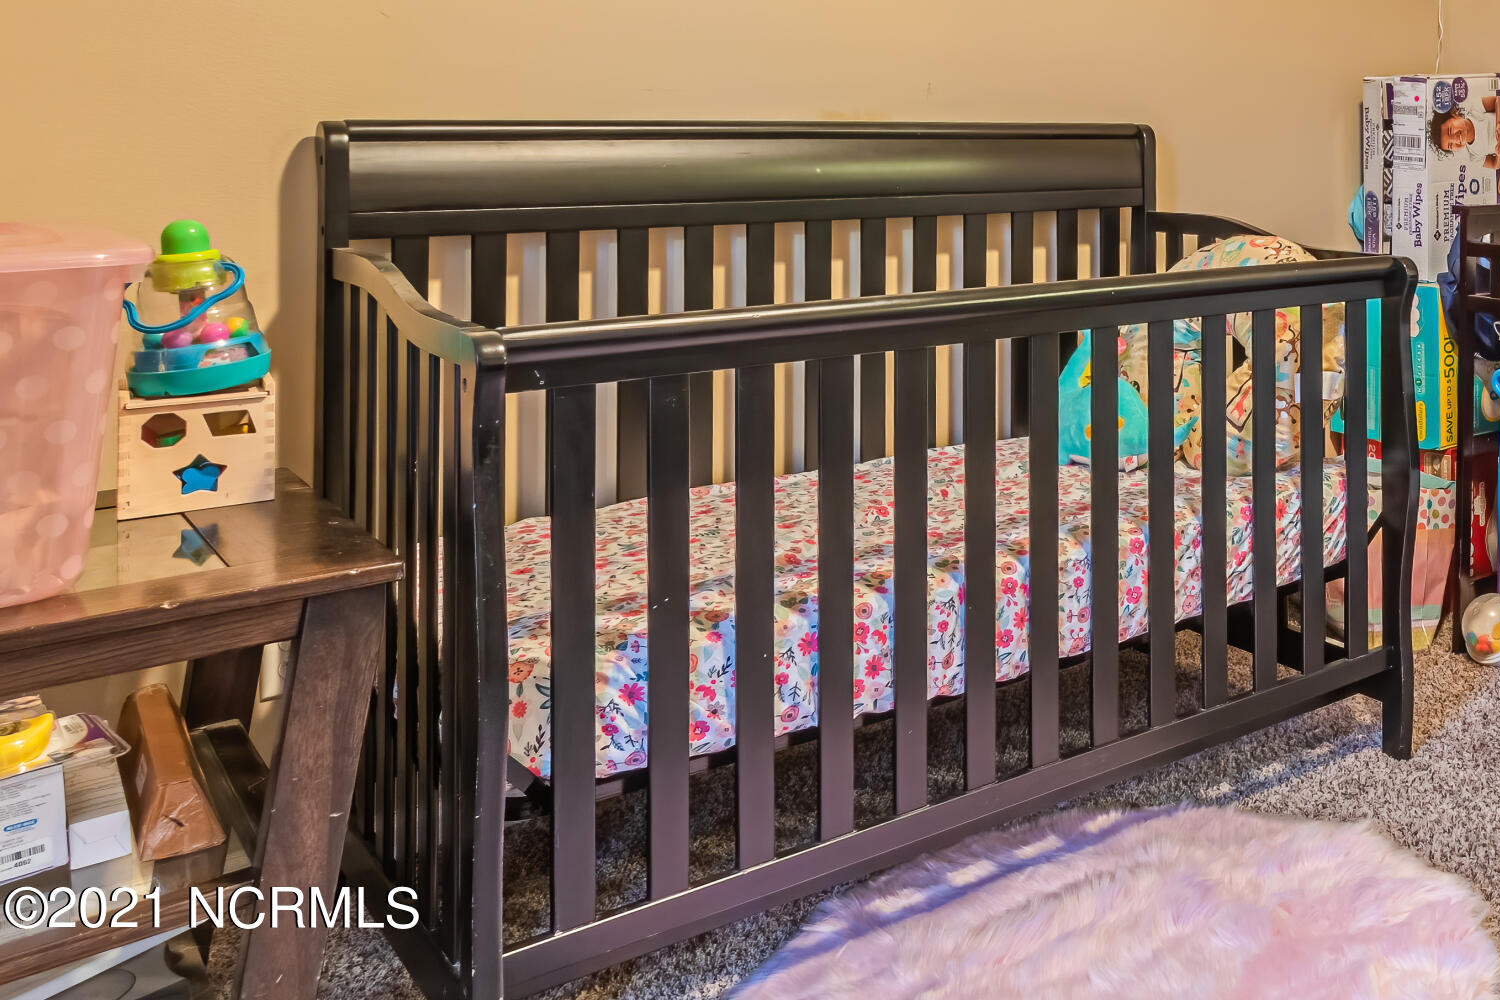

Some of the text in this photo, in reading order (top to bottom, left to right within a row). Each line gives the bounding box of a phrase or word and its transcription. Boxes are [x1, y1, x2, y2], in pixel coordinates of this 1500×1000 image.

[1412, 182, 1423, 248] Baby Wipes
[1446, 385, 1453, 397] TO
[1446, 398, 1453, 410] UP
[1446, 411, 1454, 443] SAVE
